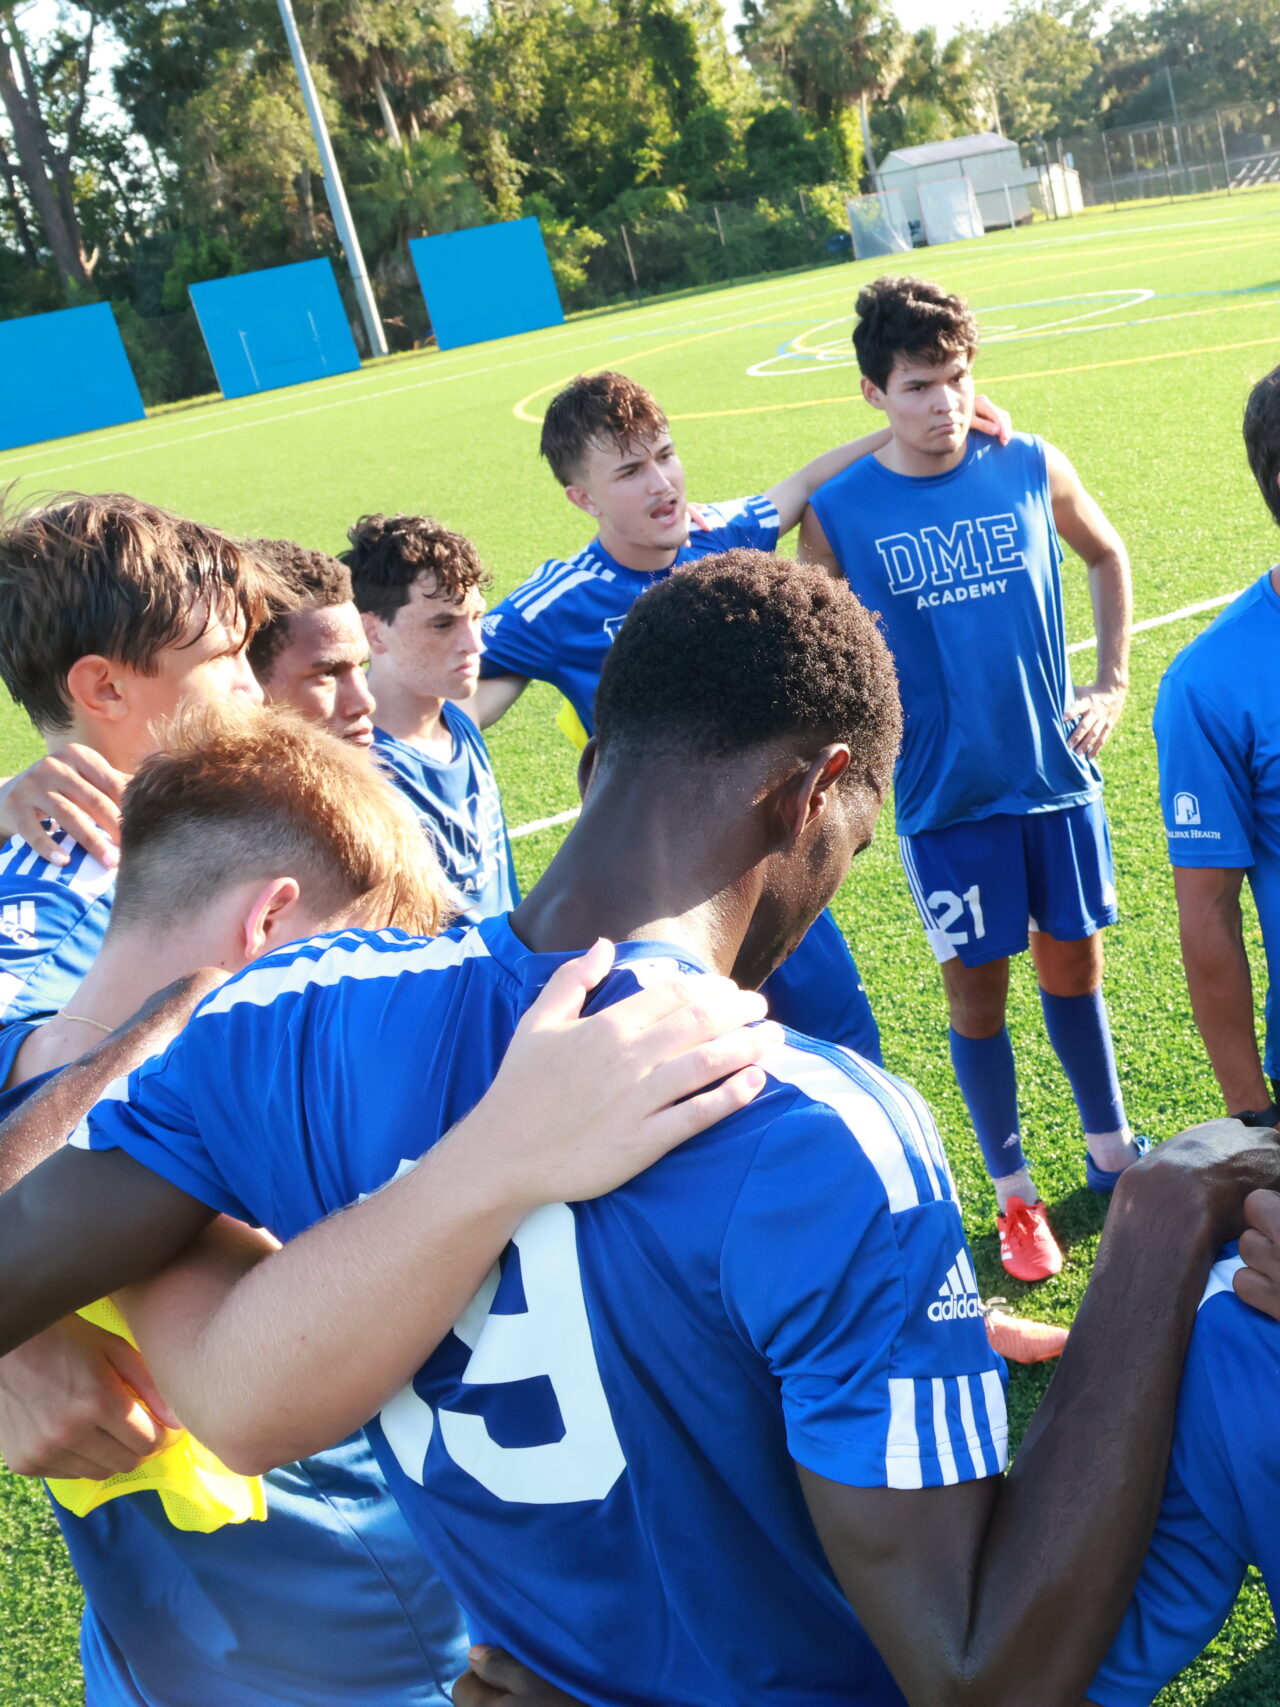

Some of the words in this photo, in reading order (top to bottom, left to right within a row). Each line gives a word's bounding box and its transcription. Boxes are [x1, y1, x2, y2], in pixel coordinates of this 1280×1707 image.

[875, 512, 1027, 596] DME
[916, 578, 1009, 611] ACADEMY
[926, 884, 986, 945] 21
